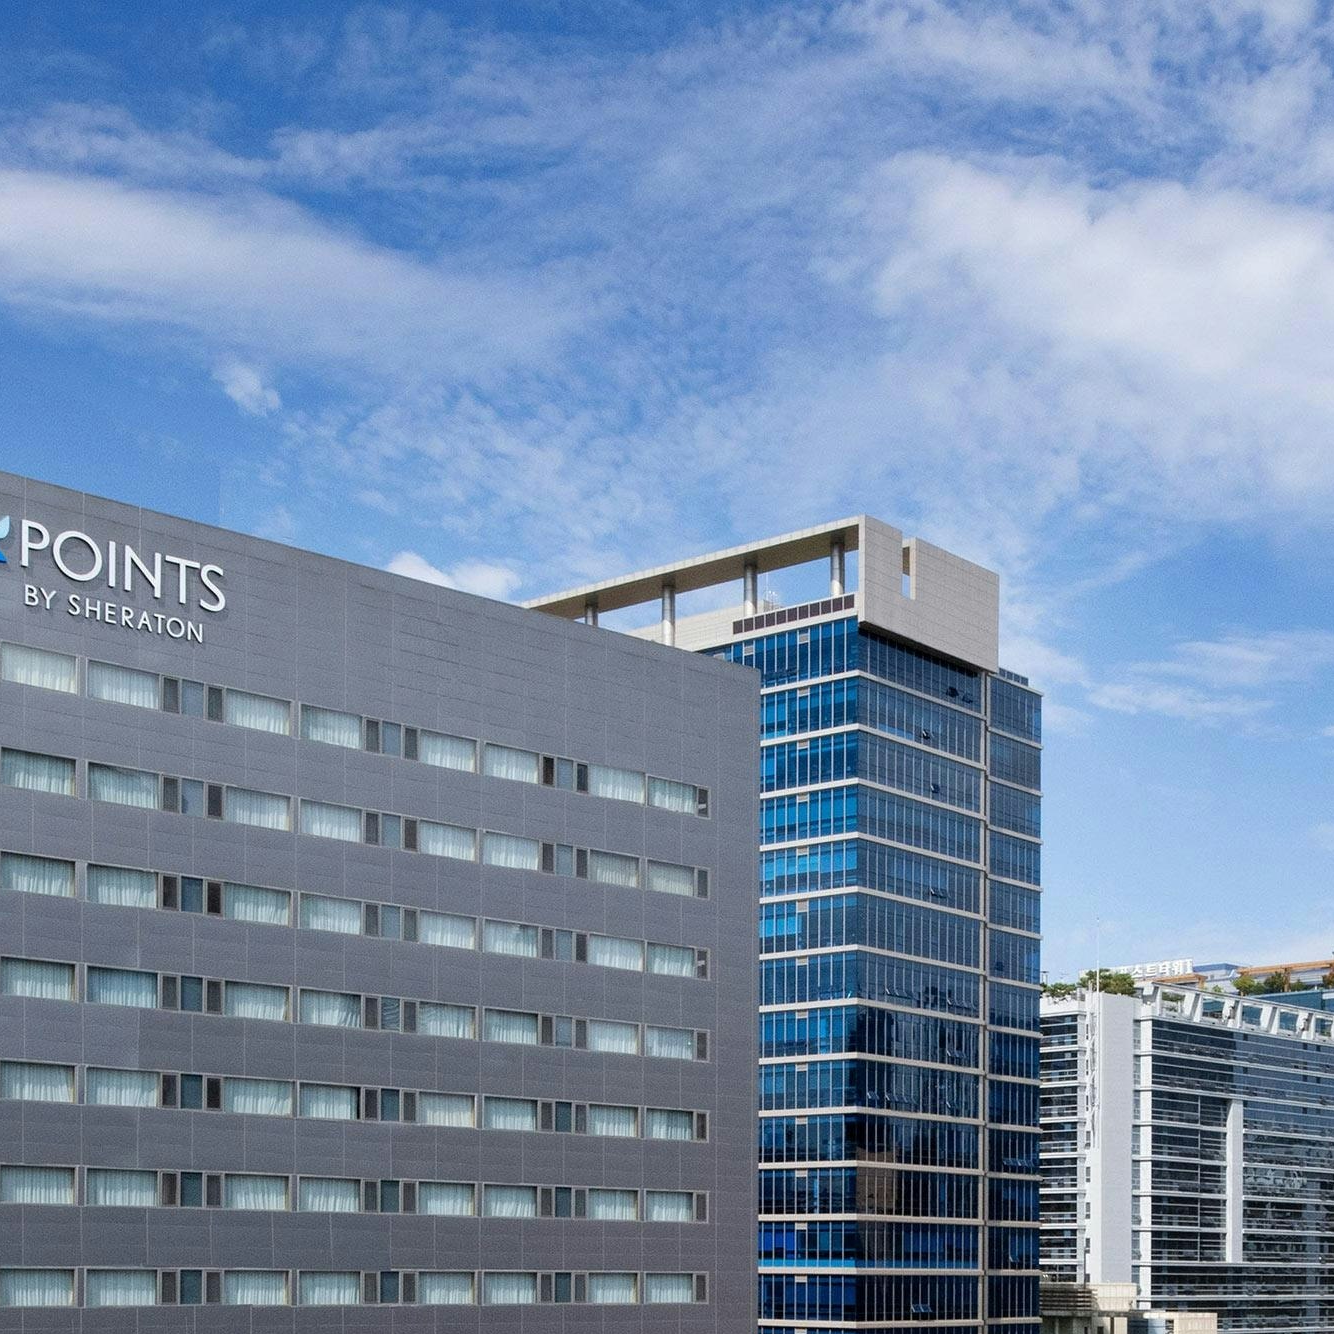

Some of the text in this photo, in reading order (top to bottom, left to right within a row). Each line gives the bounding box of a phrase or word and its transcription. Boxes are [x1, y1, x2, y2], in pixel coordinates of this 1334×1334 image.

[21, 519, 228, 612] POINTS
[24, 584, 205, 644] BY SHERATON
